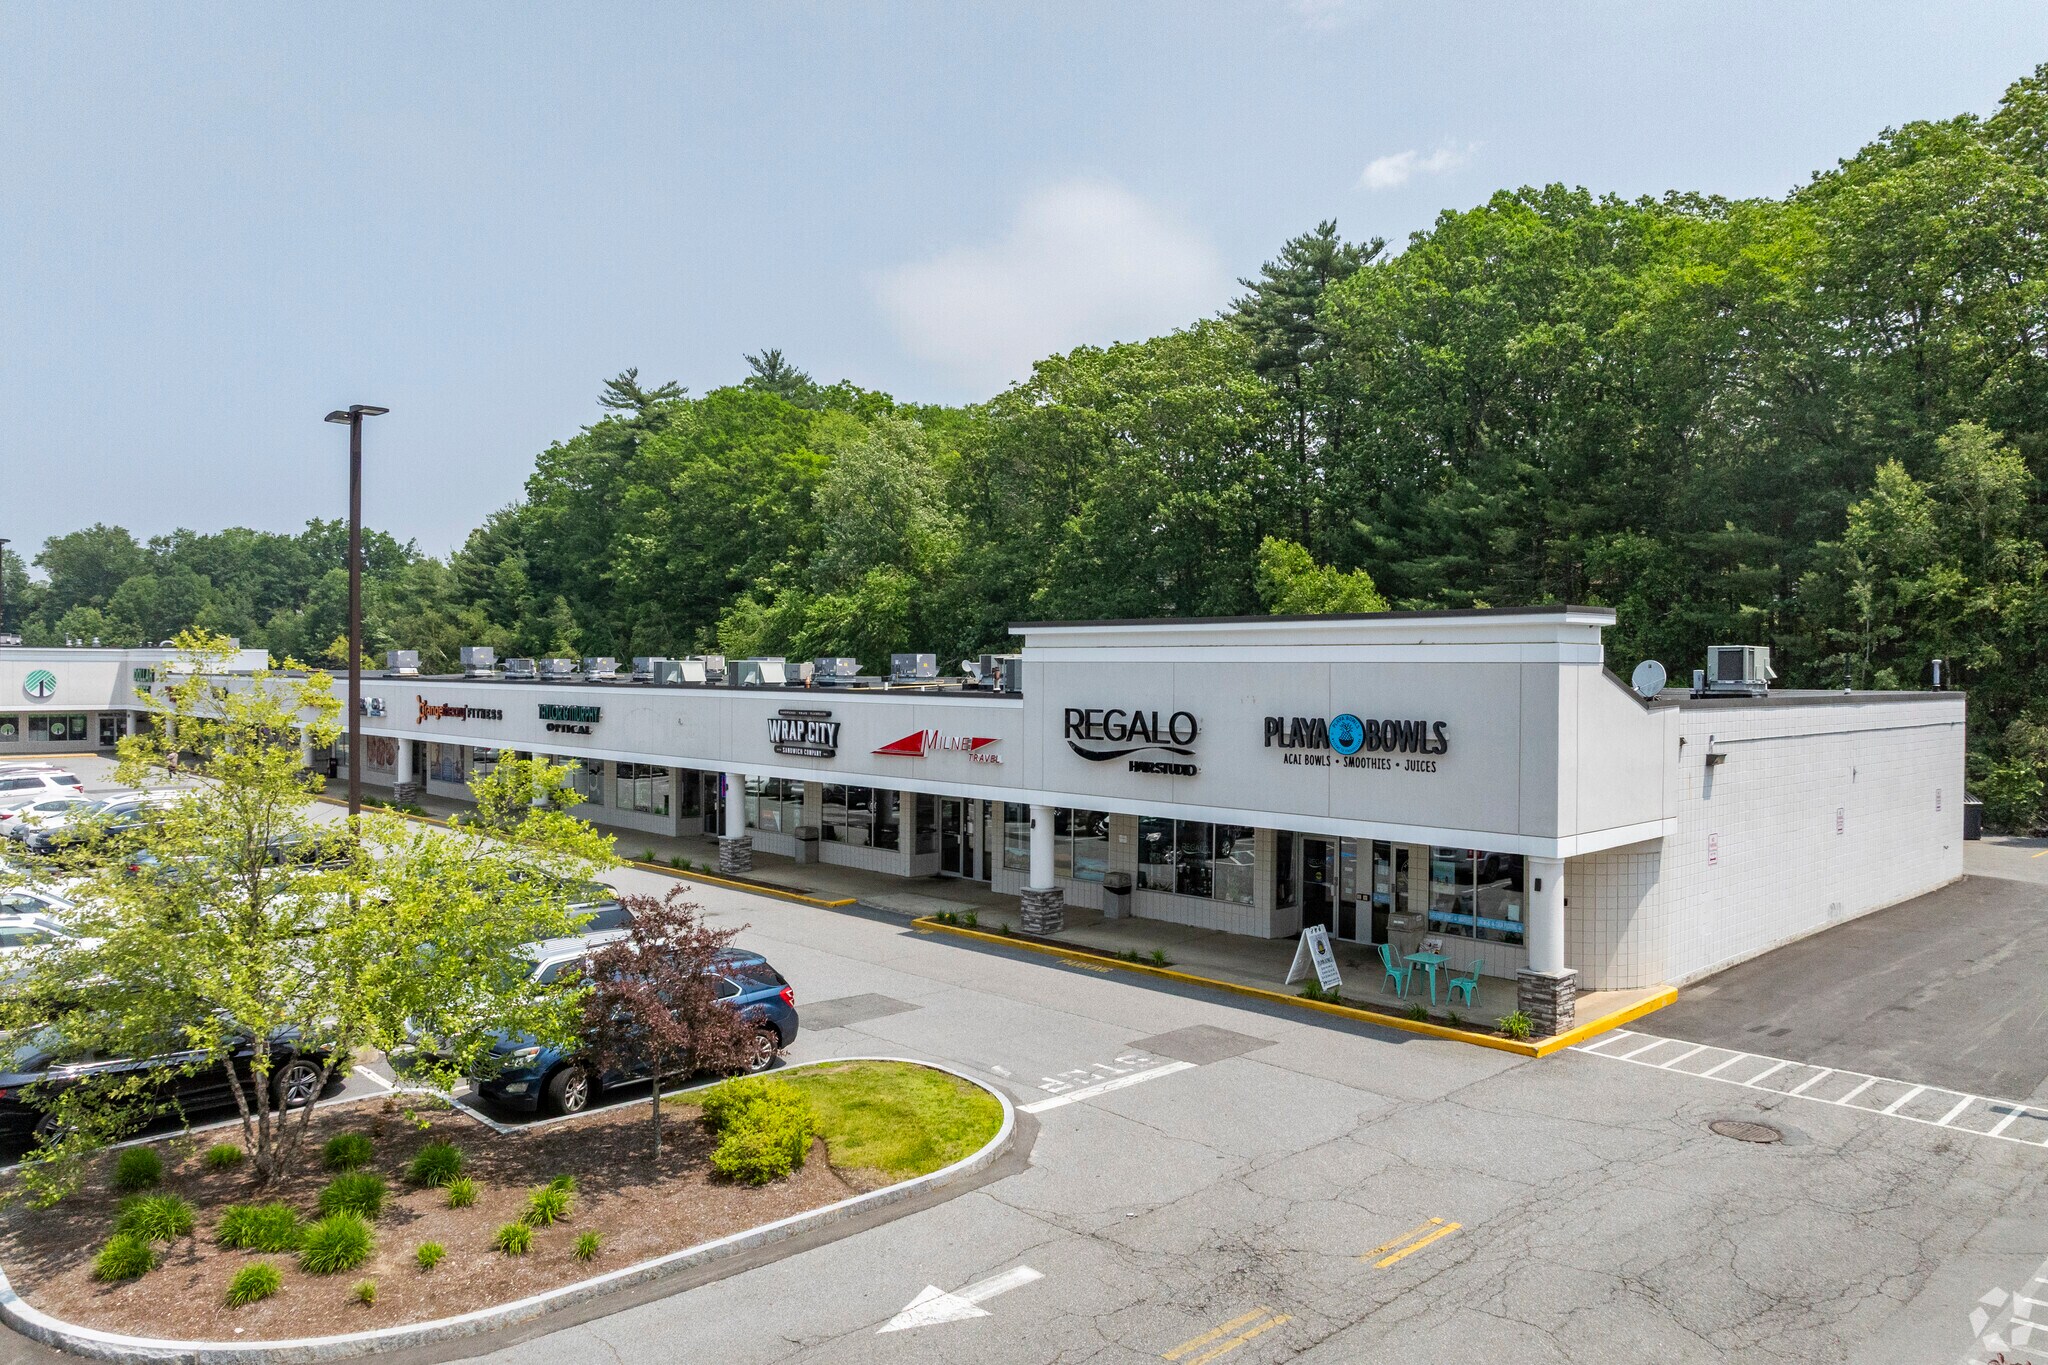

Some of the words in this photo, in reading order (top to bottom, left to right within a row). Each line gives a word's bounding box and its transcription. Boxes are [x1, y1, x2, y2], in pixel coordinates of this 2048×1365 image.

[467, 707, 503, 720] FITNESS
[546, 723, 591, 734] OPTICAL
[768, 719, 805, 743] WRAP
[807, 721, 840, 748] CITY
[1064, 708, 1198, 746] REGALO
[1264, 717, 1330, 750] PLAYA
[1365, 719, 1448, 755] BOWLS
[782, 747, 803, 755] SANDWICH
[803, 749, 822, 757] COMPANY
[968, 753, 1002, 764] TRAVEL
[1283, 753, 1302, 765] ACAI
[1304, 754, 1331, 767] BOWLS
[1343, 756, 1391, 770] SMOOTHIES
[1404, 759, 1437, 773] JUICES
